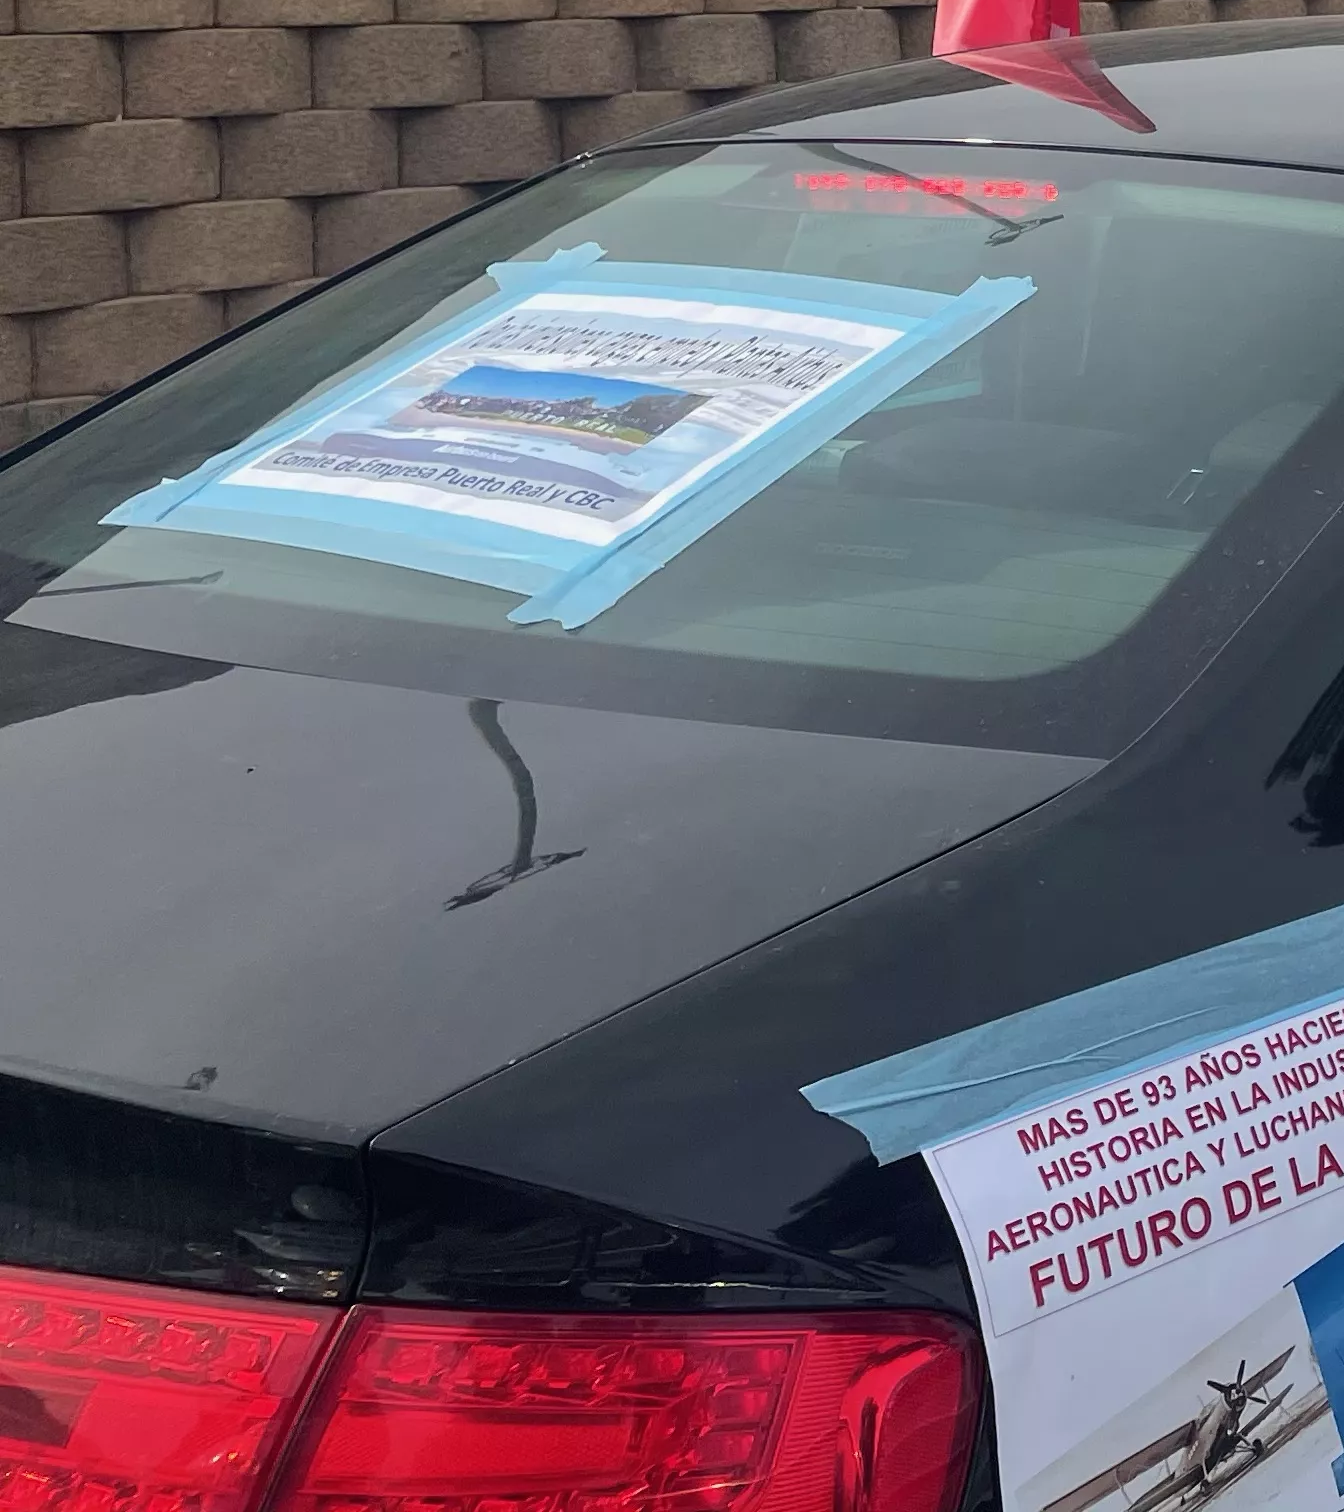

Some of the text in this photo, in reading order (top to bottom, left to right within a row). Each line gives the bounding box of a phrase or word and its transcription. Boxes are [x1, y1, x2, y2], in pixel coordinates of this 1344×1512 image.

[760, 347, 844, 391] Airbus
[272, 452, 335, 470] Comité
[334, 455, 360, 472] de
[358, 459, 433, 480] Empresa
[434, 468, 504, 493] Puerto
[504, 479, 546, 499] Real
[563, 490, 616, 511] CBC
[1016, 1107, 1090, 1156] MAS
[1093, 1088, 1138, 1126] DE
[1141, 1074, 1178, 1108] 93
[1184, 1043, 1263, 1095] AÑOS
[1037, 1118, 1184, 1192] HISTORIA
[1185, 1096, 1228, 1137] EN
[1230, 1082, 1273, 1118] LA
[986, 1151, 1207, 1262] AERONAUTICA
[1207, 1137, 1226, 1167] Y
[1028, 1196, 1213, 1309] FUTURO
[1222, 1165, 1284, 1226] DE
